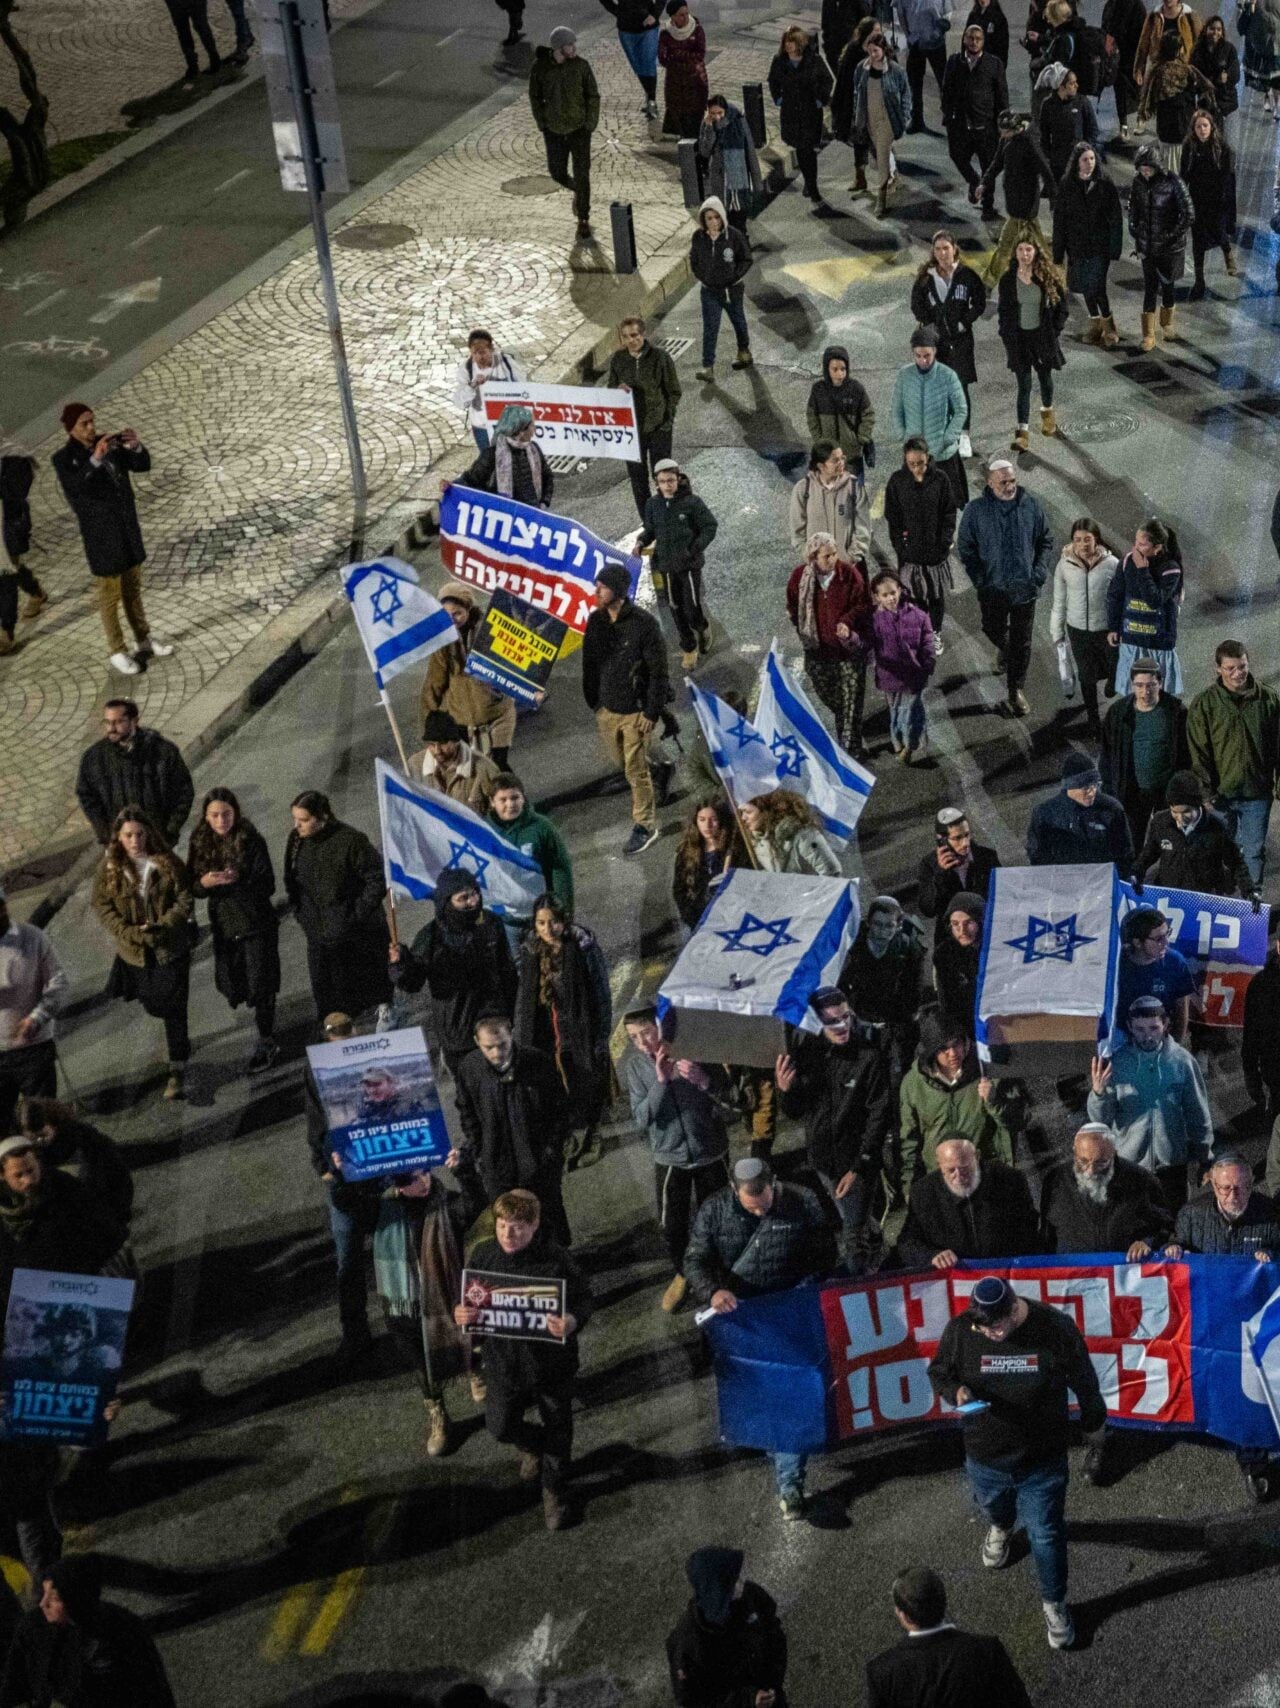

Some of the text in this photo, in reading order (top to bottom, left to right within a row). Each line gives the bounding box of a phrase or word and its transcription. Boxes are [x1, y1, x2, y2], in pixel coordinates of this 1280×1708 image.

[558, 404, 582, 423] לנו
[588, 409, 616, 425] אין
[563, 425, 634, 446] לעסקאות
[457, 500, 588, 568] לניצחון
[1196, 910, 1241, 955] כן
[347, 1128, 366, 1141] לנו
[390, 1117, 430, 1132] במותם
[352, 1127, 434, 1162] ניצחון
[491, 1292, 529, 1308] בראש
[525, 1311, 549, 1331] כל
[12, 1391, 97, 1420] ניצחון
